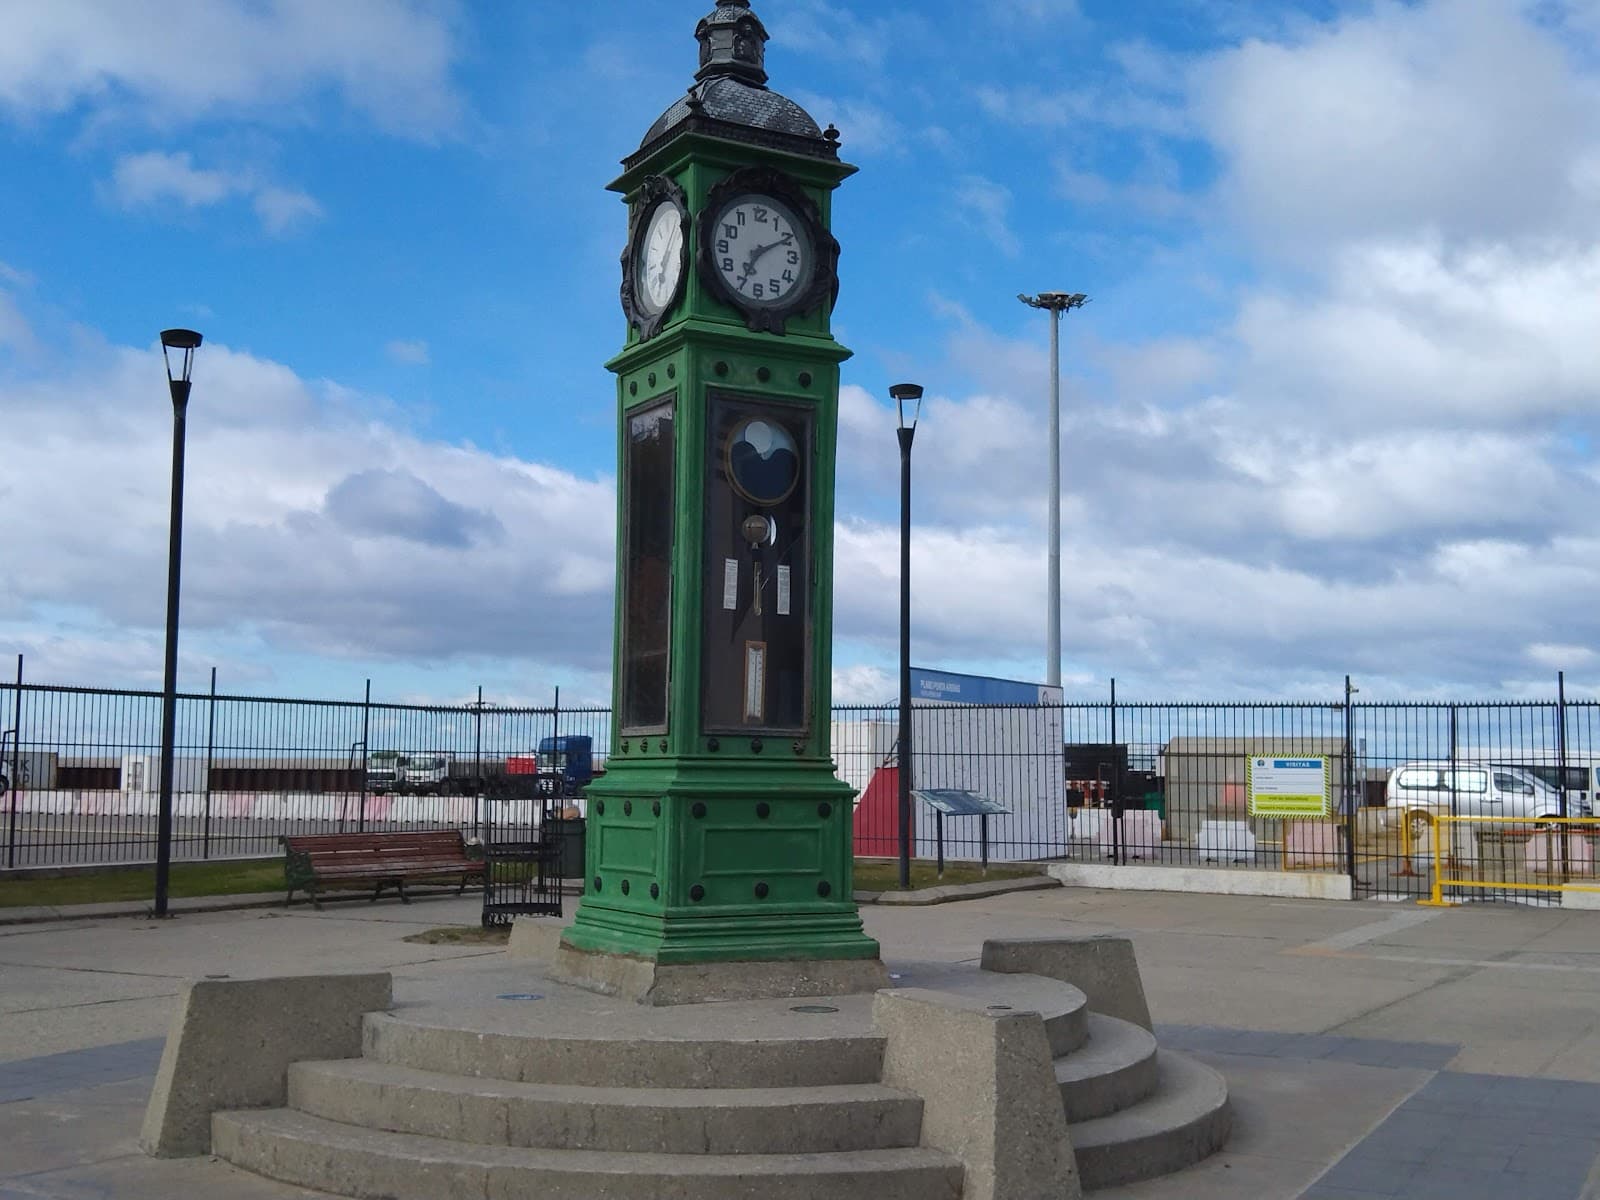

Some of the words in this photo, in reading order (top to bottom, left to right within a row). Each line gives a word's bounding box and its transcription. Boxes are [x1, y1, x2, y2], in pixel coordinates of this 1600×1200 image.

[752, 206, 768, 224] 12
[724, 223, 738, 239] 10
[773, 215, 780, 232] 1
[717, 240, 729, 254] 9
[781, 232, 794, 247] 2
[722, 258, 734, 272] 8
[787, 250, 800, 265] 3
[736, 275, 748, 291] 7
[782, 269, 794, 284] 4
[753, 283, 764, 298] 6
[769, 278, 781, 295] 5
